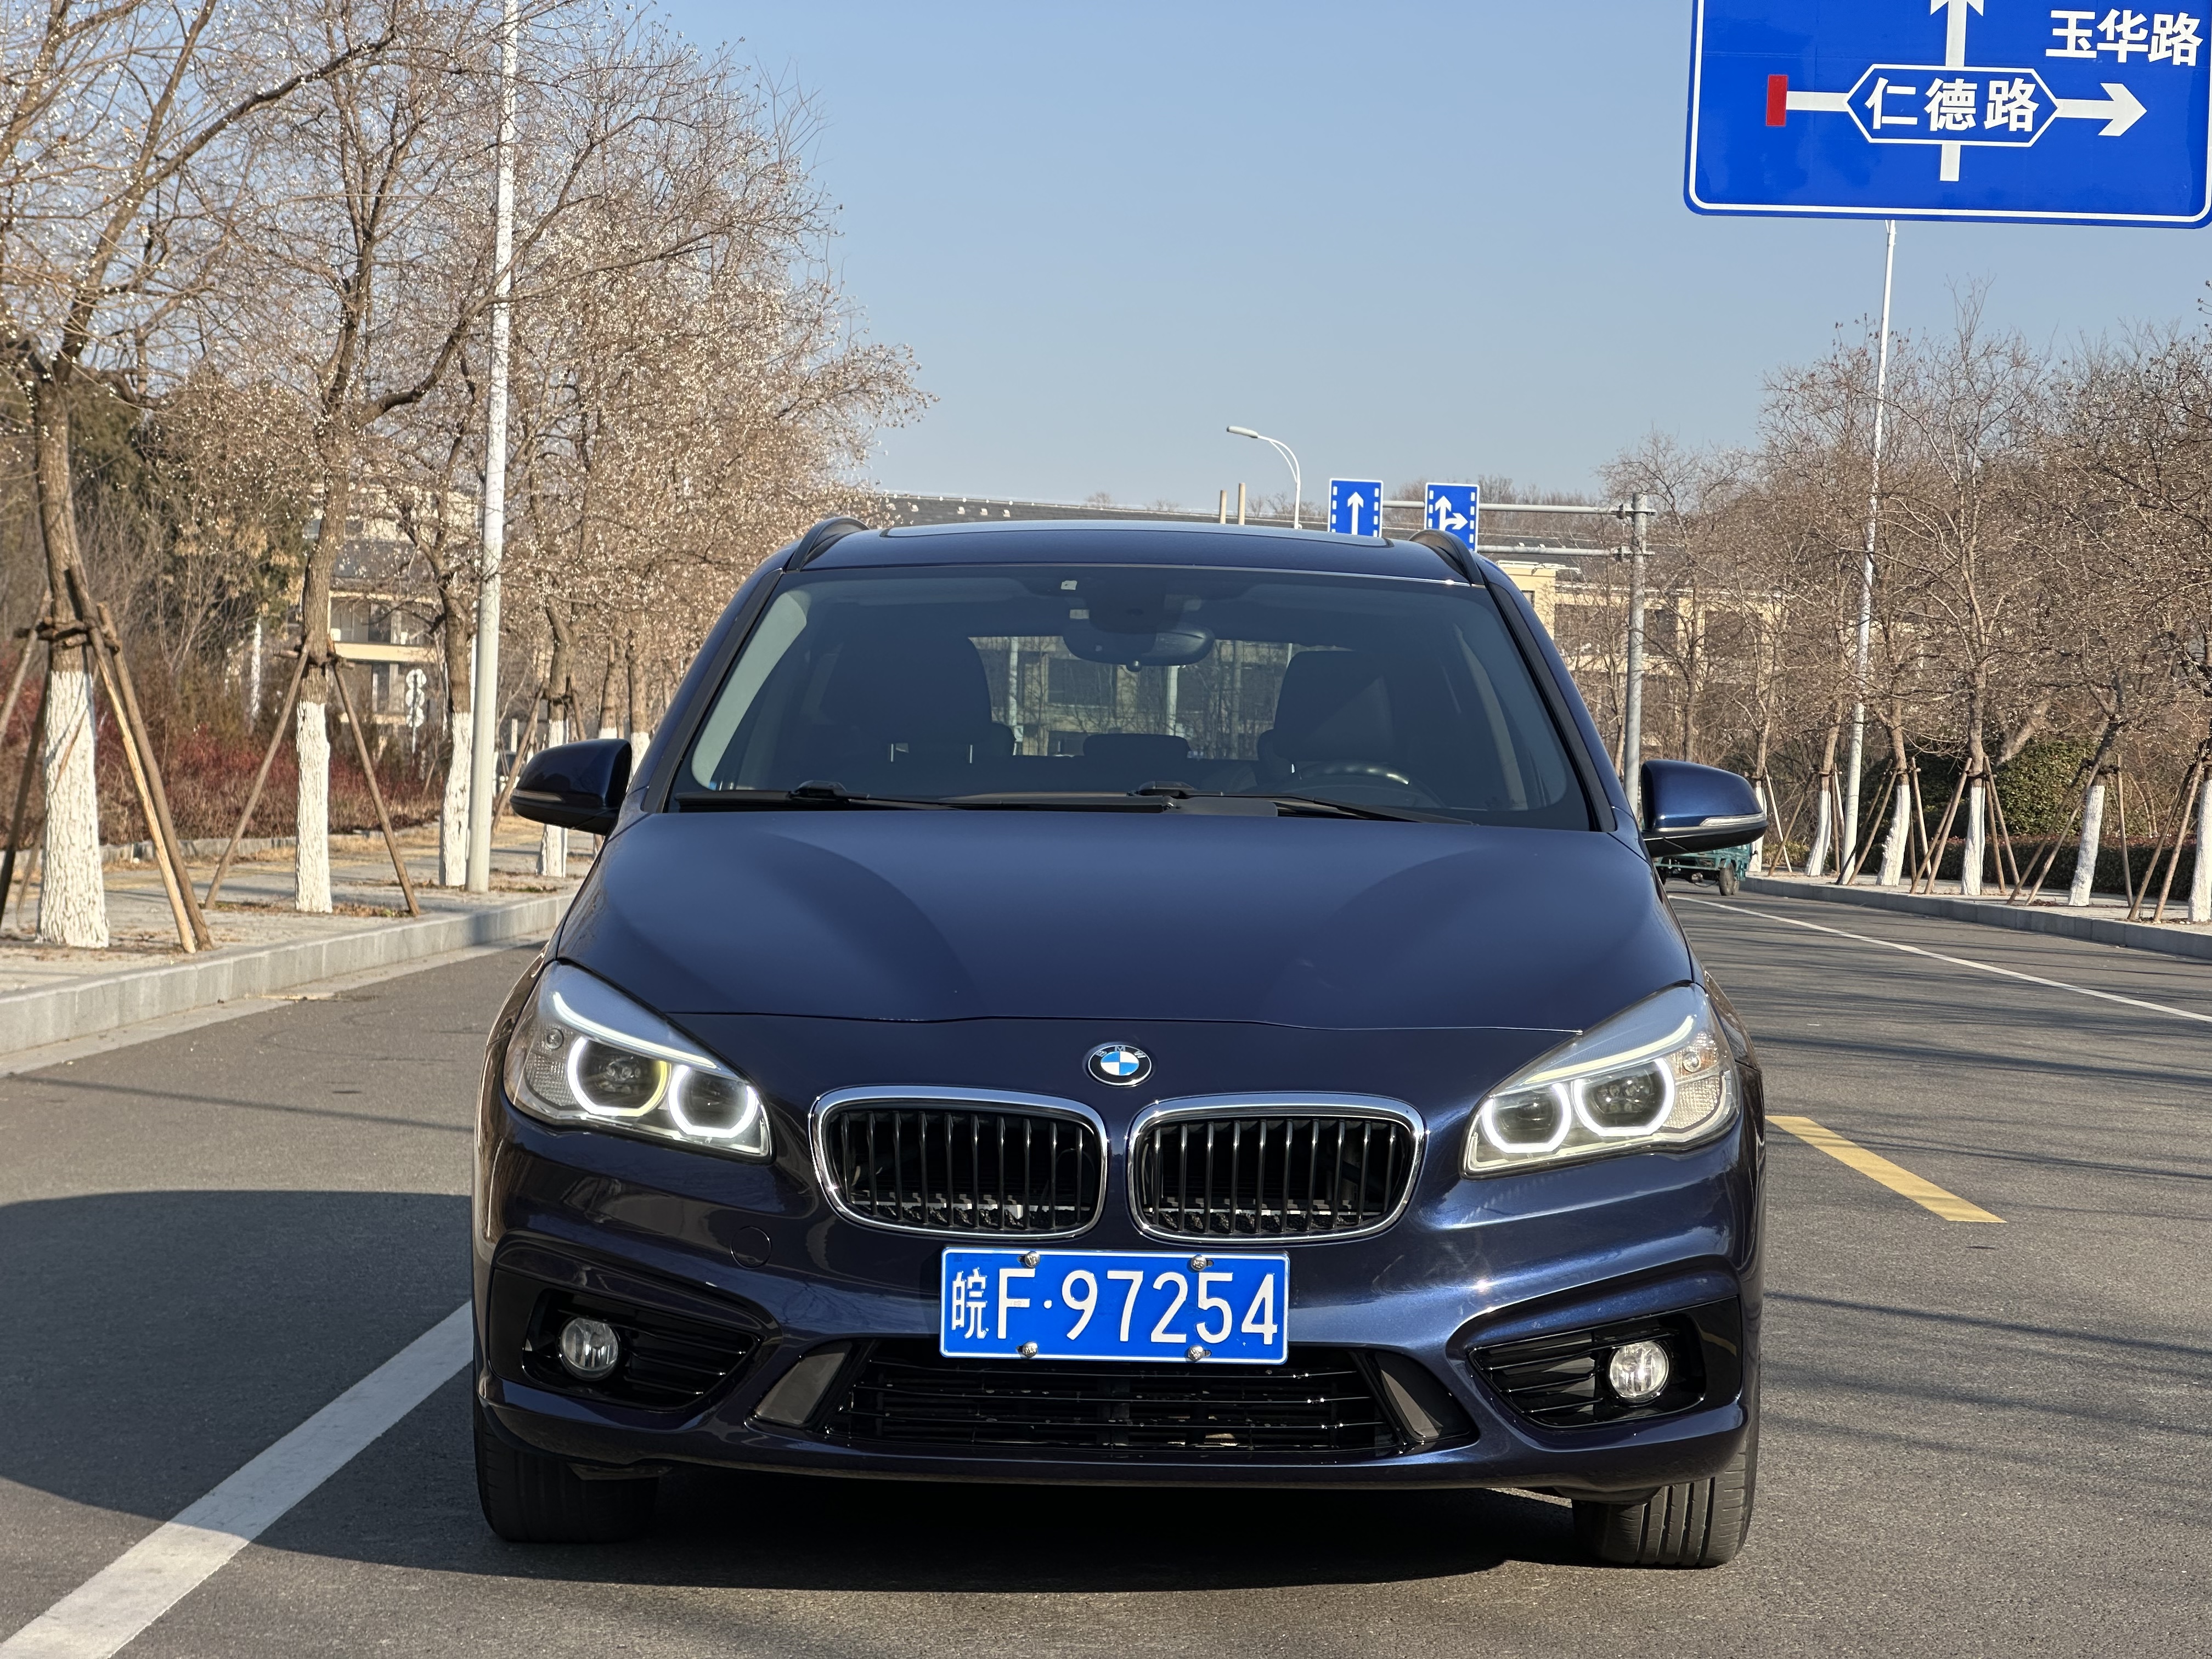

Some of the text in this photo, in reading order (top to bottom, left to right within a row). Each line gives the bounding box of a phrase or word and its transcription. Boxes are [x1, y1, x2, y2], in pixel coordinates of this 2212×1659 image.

[2045, 9, 2203, 66] 玉华路
[1865, 77, 2039, 132] 仁德路
[1096, 1046, 1146, 1058] BMW
